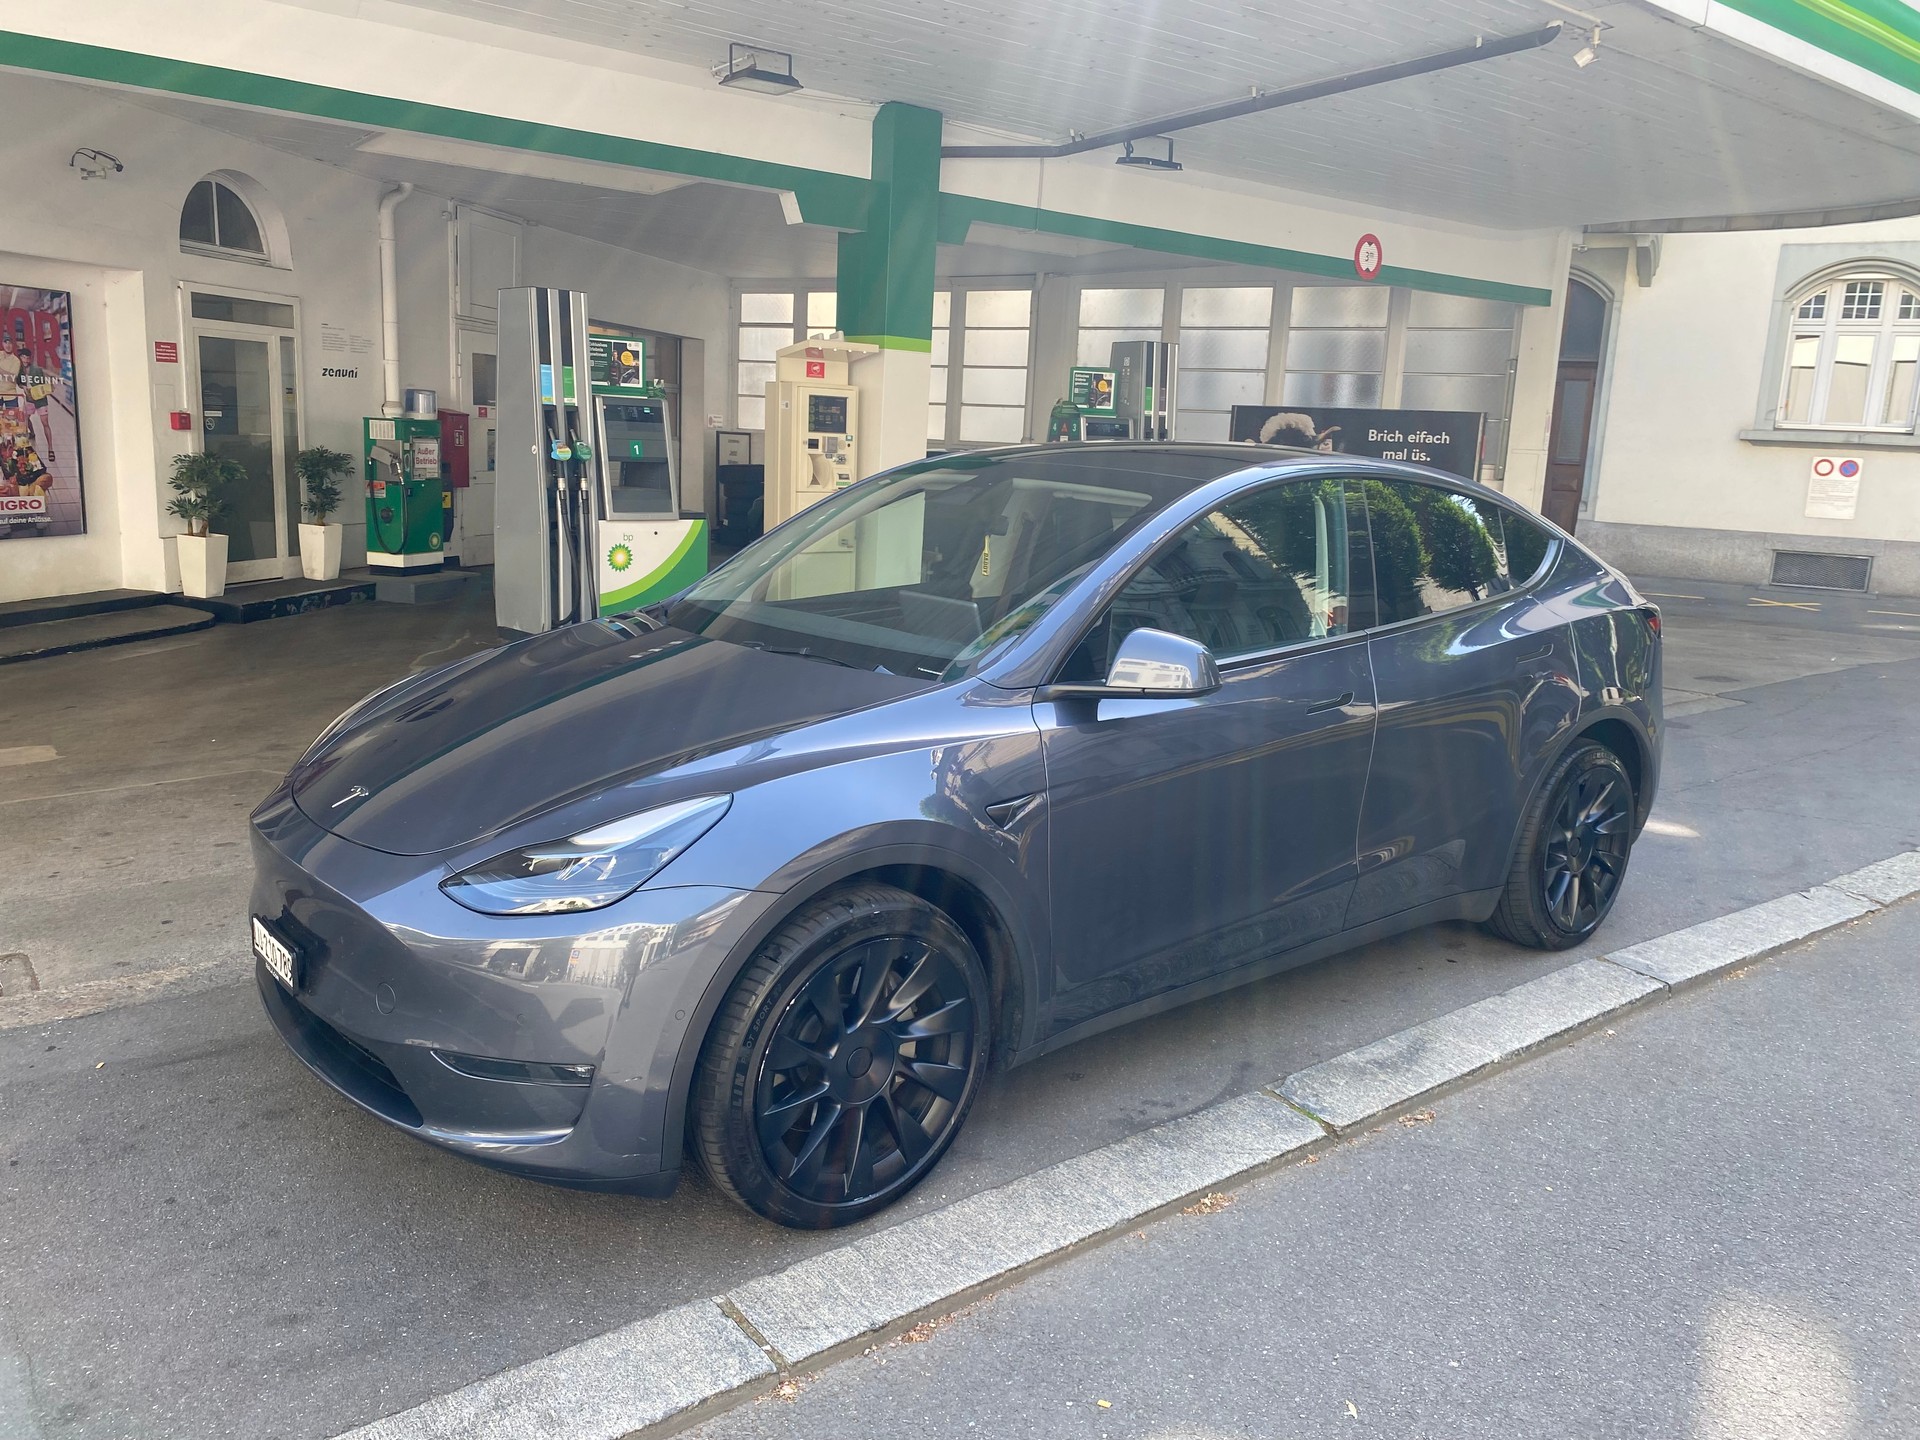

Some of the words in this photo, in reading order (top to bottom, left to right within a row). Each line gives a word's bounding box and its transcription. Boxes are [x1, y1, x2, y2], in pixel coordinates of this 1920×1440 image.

[0, 307, 62, 369] OR
[322, 367, 358, 378] zenuni
[21, 374, 64, 385] BEGINNT
[1052, 422, 1057, 432] 4
[1072, 422, 1077, 432] 3
[1368, 429, 1403, 443] Brich
[1407, 431, 1450, 444] eifach
[416, 447, 436, 455] Außer
[633, 444, 640, 455] 1
[415, 457, 437, 465] Betrieb
[1382, 449, 1407, 461] mal
[1411, 449, 1431, 462] üs.
[9, 516, 26, 524] deine
[623, 532, 633, 542] bp
[752, 998, 773, 1032] SPORT
